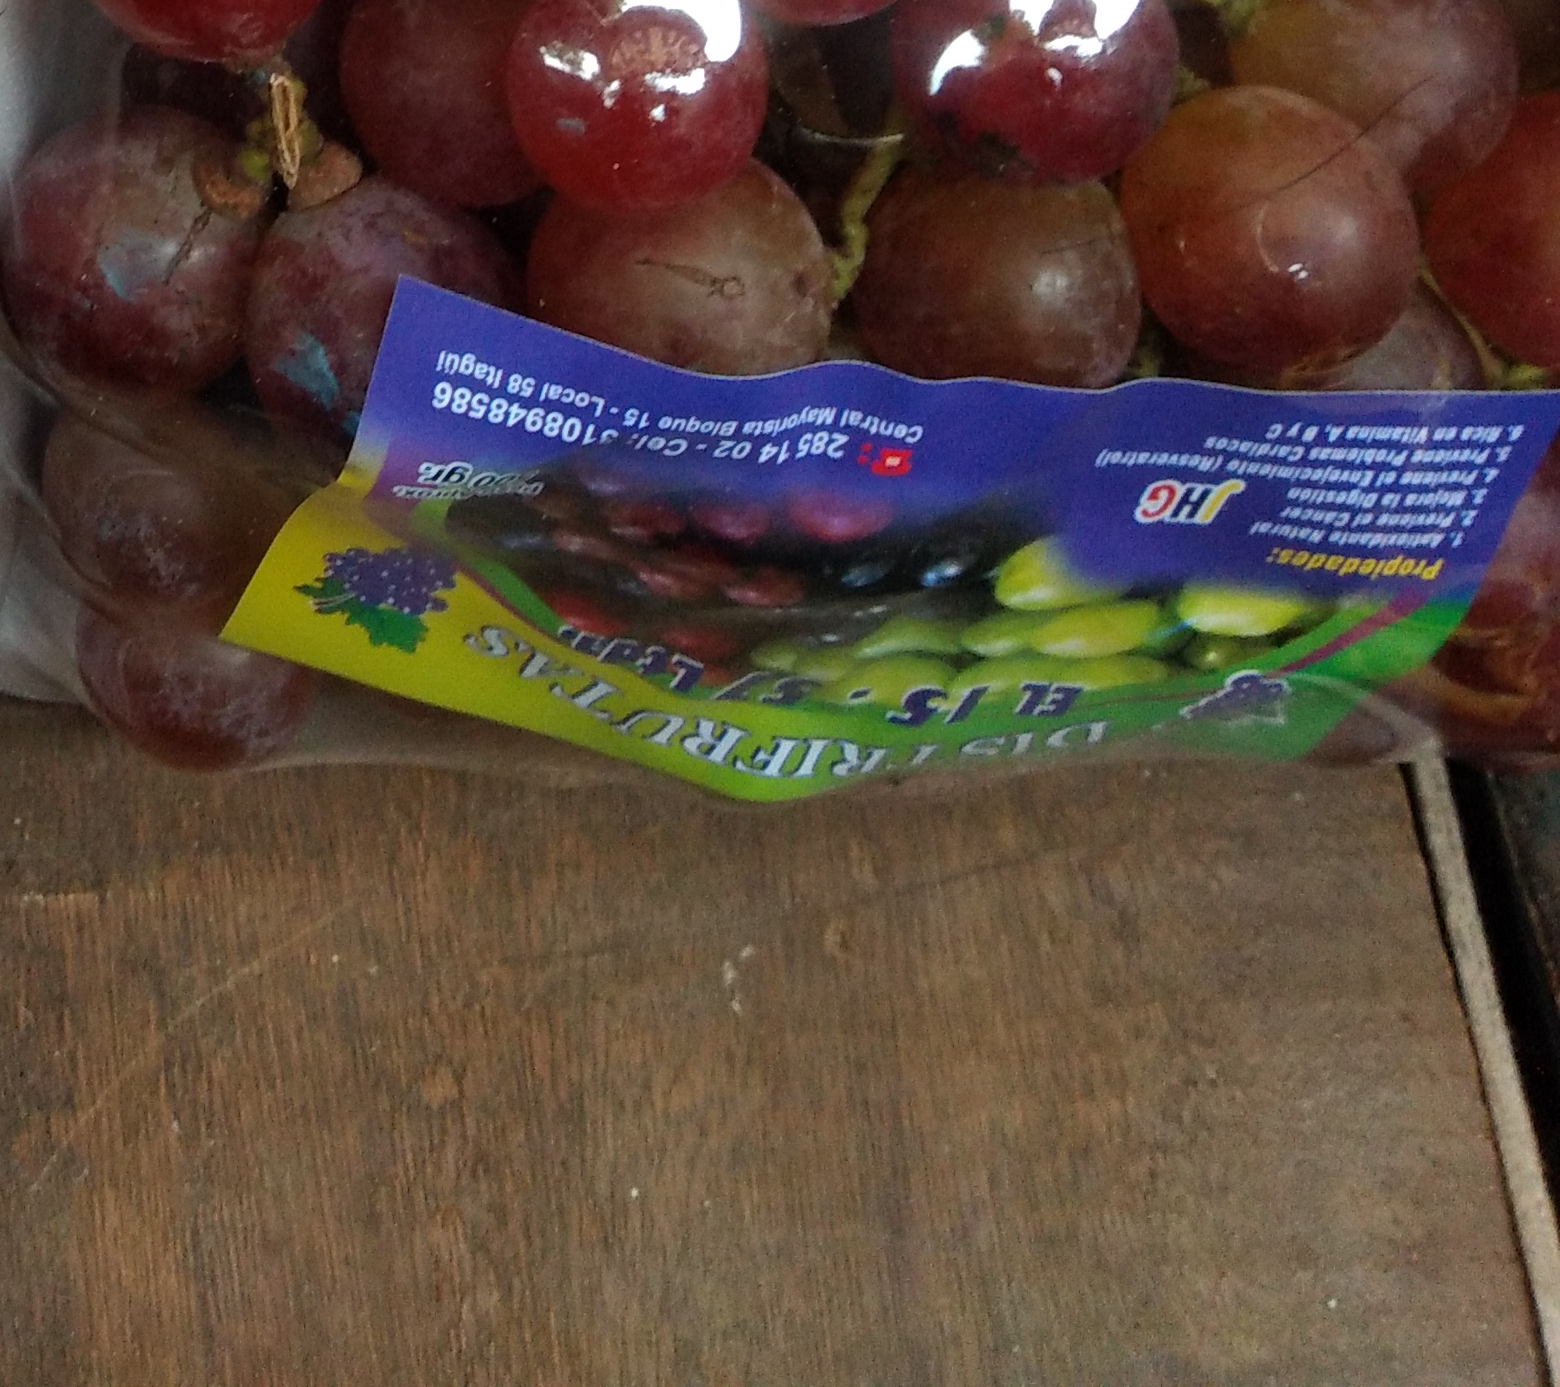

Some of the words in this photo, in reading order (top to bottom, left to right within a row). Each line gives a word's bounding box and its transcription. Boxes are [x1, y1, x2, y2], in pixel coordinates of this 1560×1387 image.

[505, 373, 537, 398] 58
[538, 381, 606, 417] Local
[431, 380, 620, 447] 3108948586
[622, 407, 651, 430] 15
[742, 404, 839, 436] Mayorista
[839, 407, 925, 445] Central
[711, 438, 753, 461] 02
[757, 438, 792, 466] 14
[794, 430, 851, 461] 285
[1132, 478, 1247, 526] JHG
[1265, 546, 1445, 581] Propiedades:
[885, 683, 991, 727] 15
[1013, 681, 1085, 717] EL
